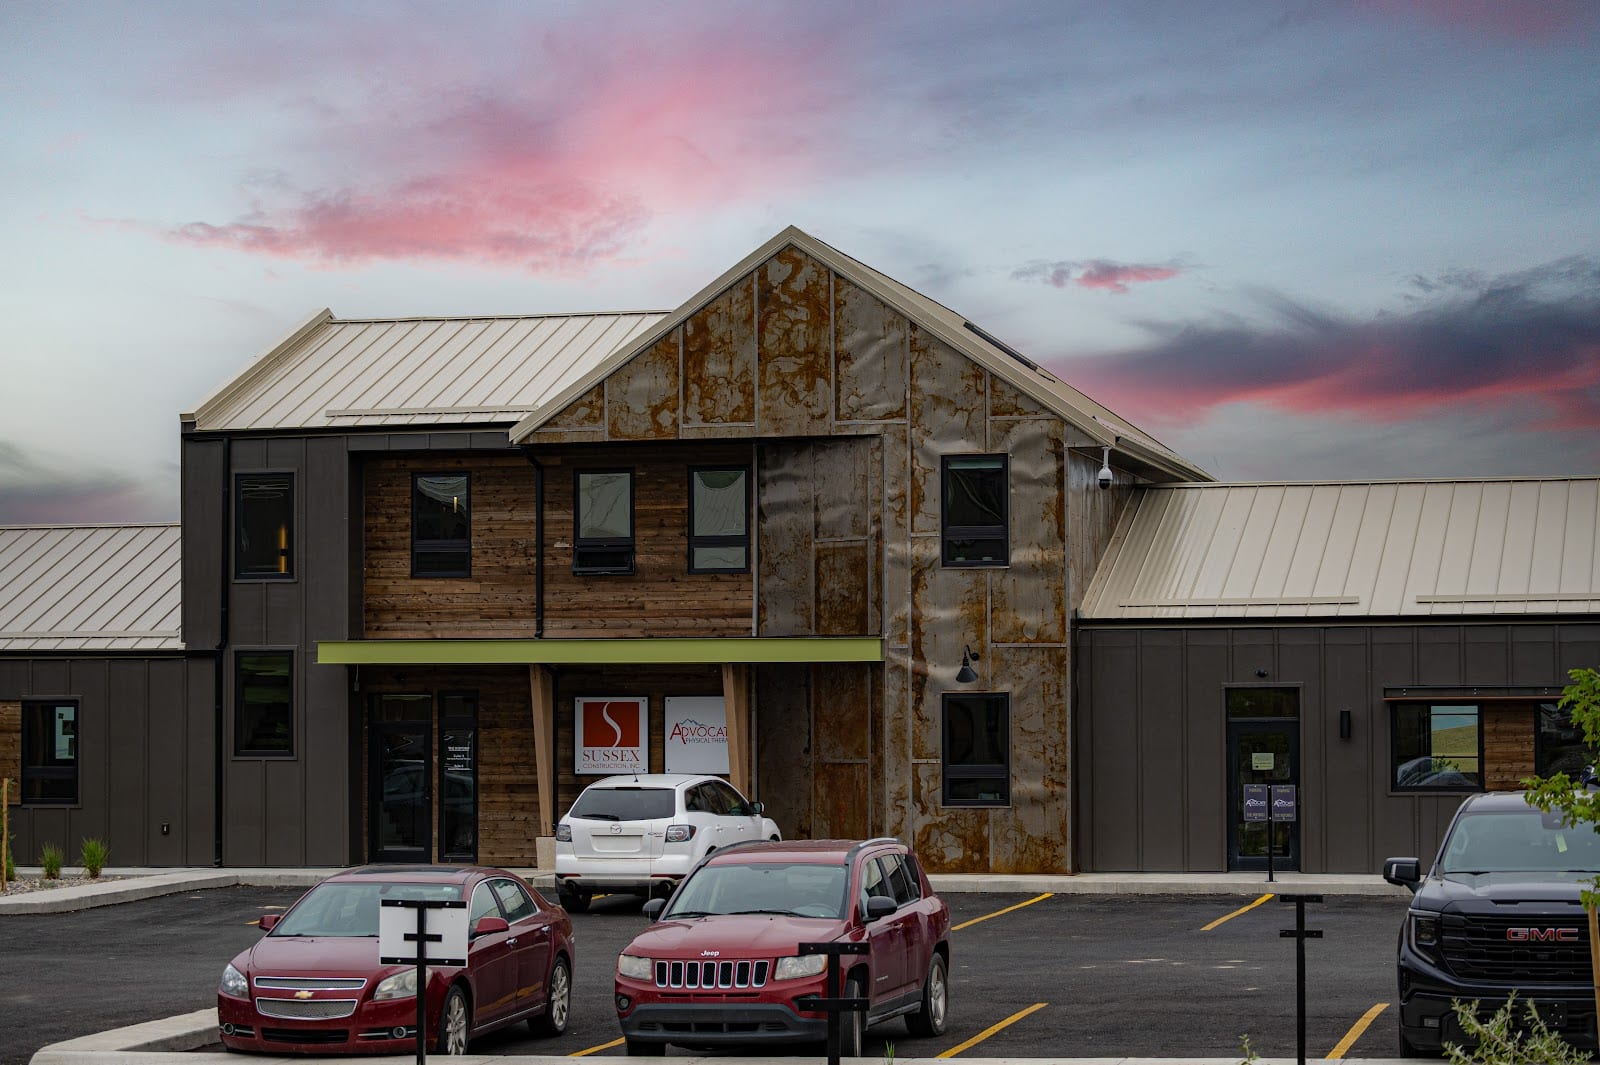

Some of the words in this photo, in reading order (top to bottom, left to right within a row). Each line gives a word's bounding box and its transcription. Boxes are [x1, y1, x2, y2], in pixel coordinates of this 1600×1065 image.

[669, 722, 728, 744] ADVOCAT
[582, 750, 640, 762] SUSSEX
[1506, 927, 1579, 942] GMC
[700, 949, 720, 957] Jeep
